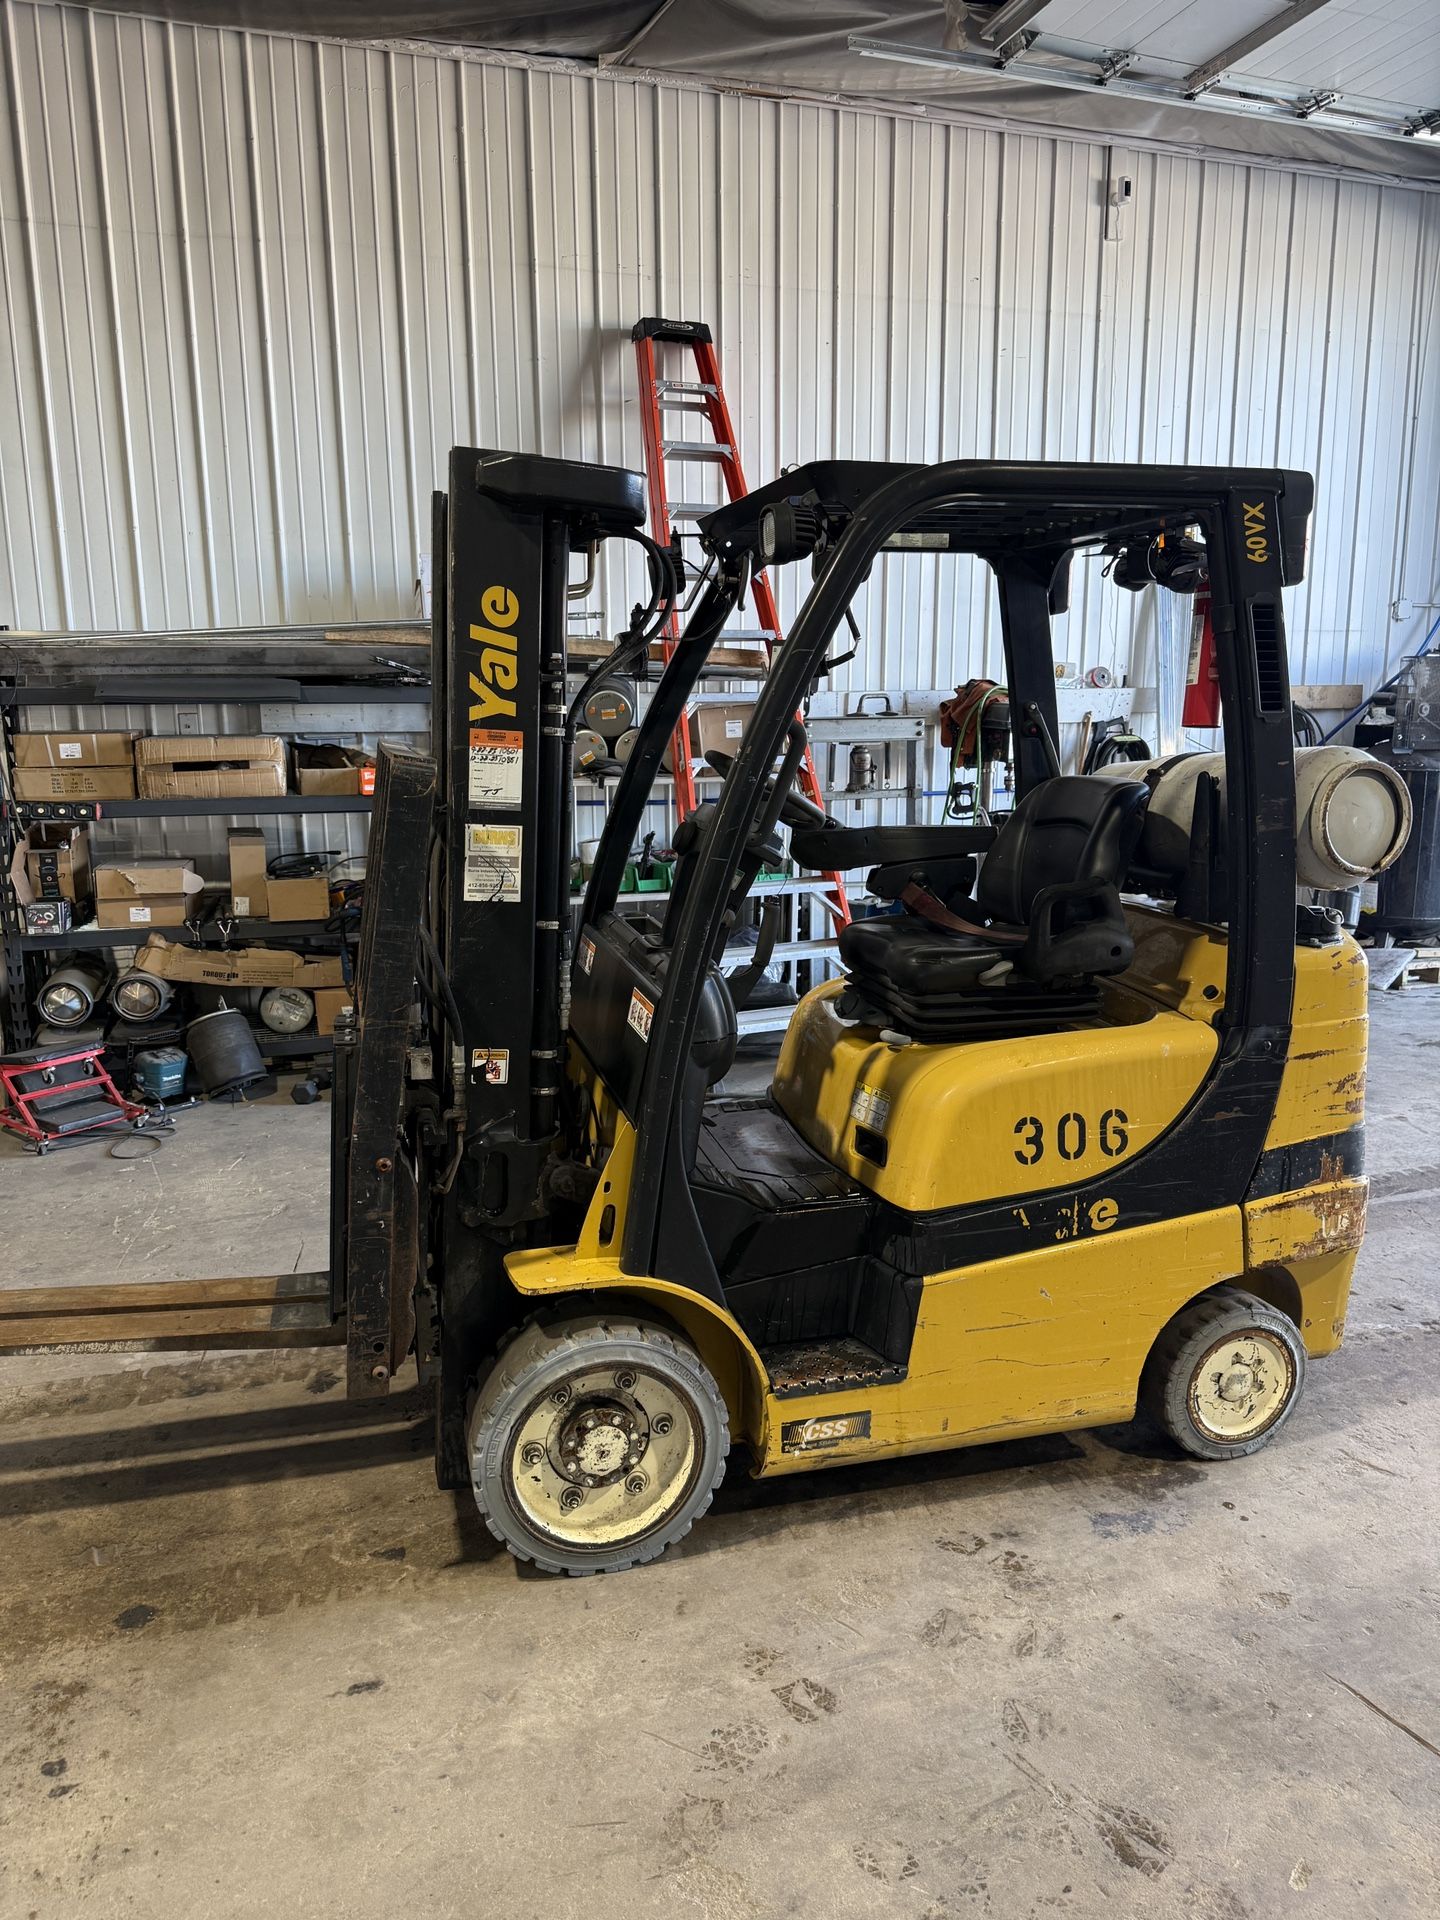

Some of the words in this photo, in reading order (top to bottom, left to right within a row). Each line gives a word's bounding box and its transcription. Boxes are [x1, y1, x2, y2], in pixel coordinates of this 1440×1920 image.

[1242, 501, 1268, 563] 60VX
[469, 585, 520, 722] Yale
[1014, 1108, 1129, 1166] 306
[663, 1357, 704, 1397] SOLIDEAL
[485, 1405, 516, 1479] MAGNUM
[805, 1419, 848, 1442] CSS
